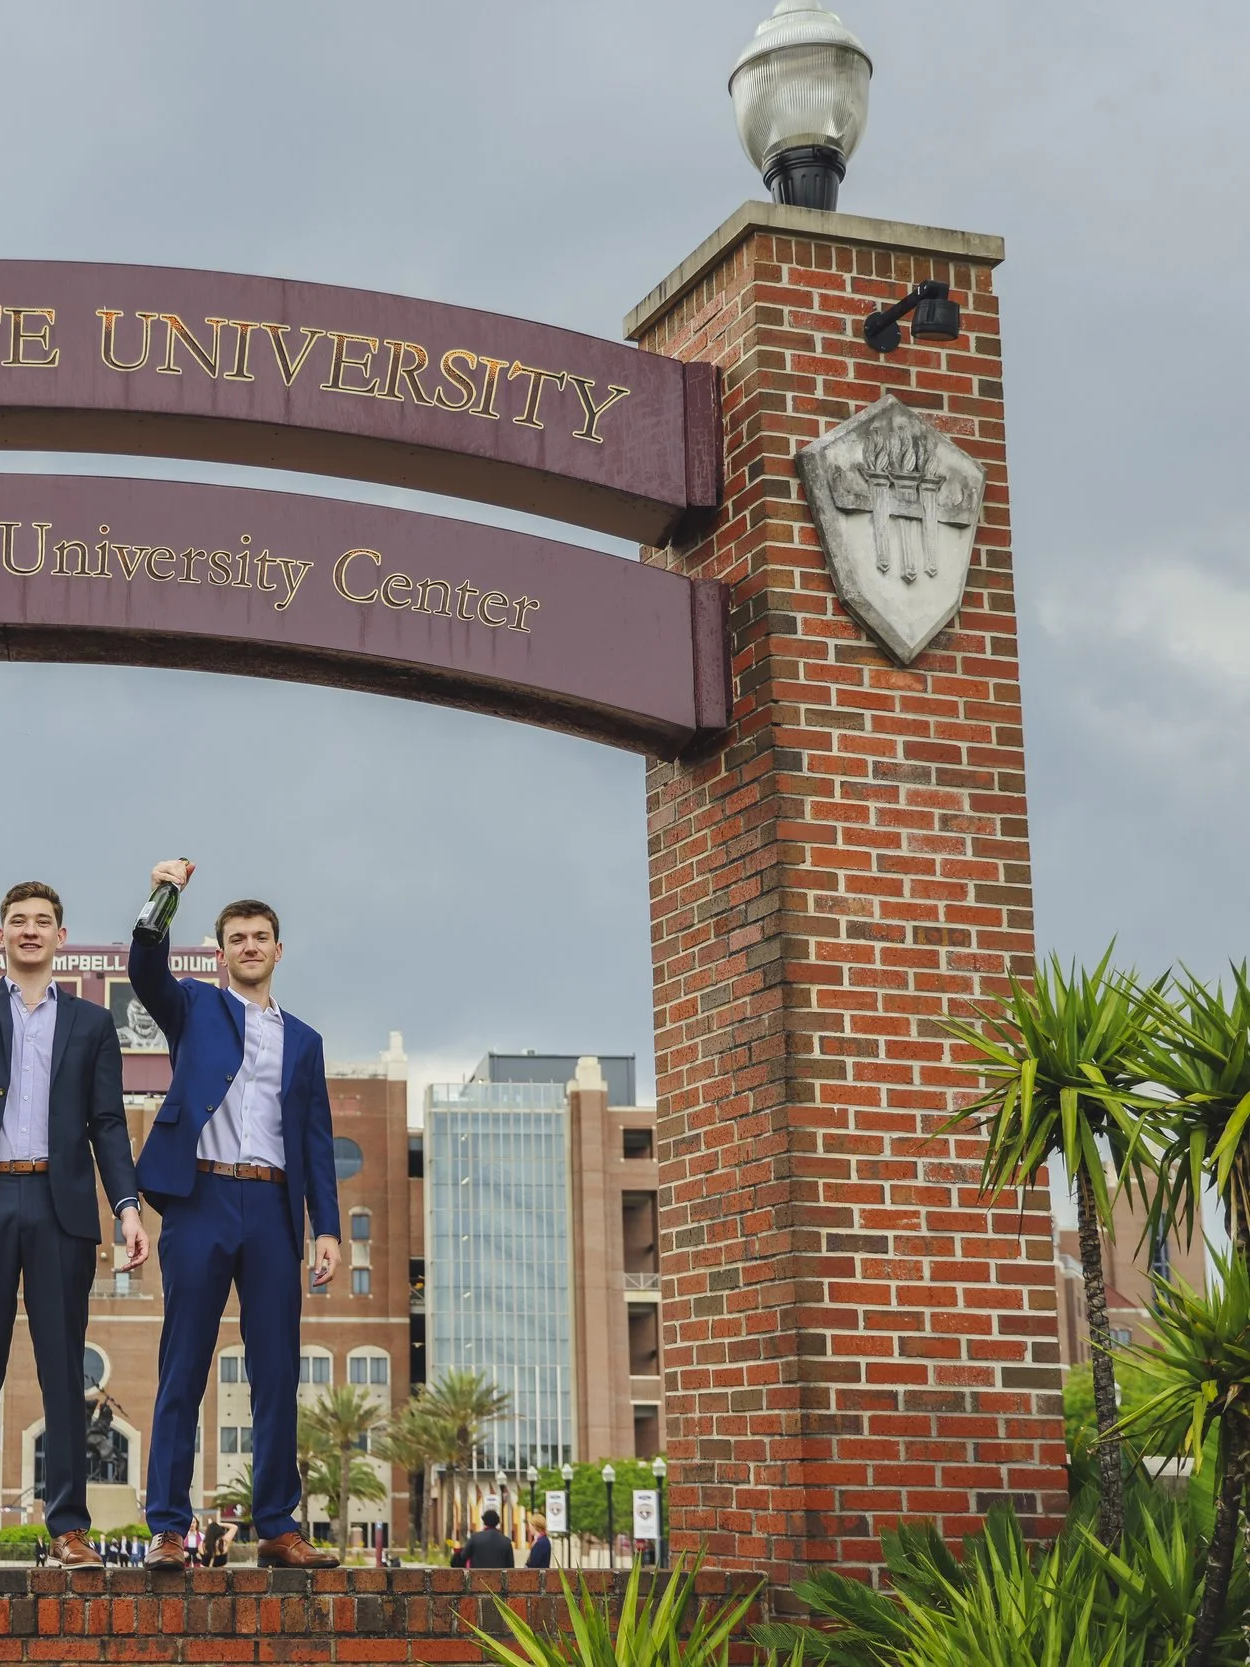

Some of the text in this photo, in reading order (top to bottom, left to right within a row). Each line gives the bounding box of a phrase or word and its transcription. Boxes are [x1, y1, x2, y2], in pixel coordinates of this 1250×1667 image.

[95, 307, 631, 444] UNIVERSITY
[332, 548, 540, 634] Center
[52, 955, 126, 971] MPBELL
[170, 955, 218, 972] DIUM
